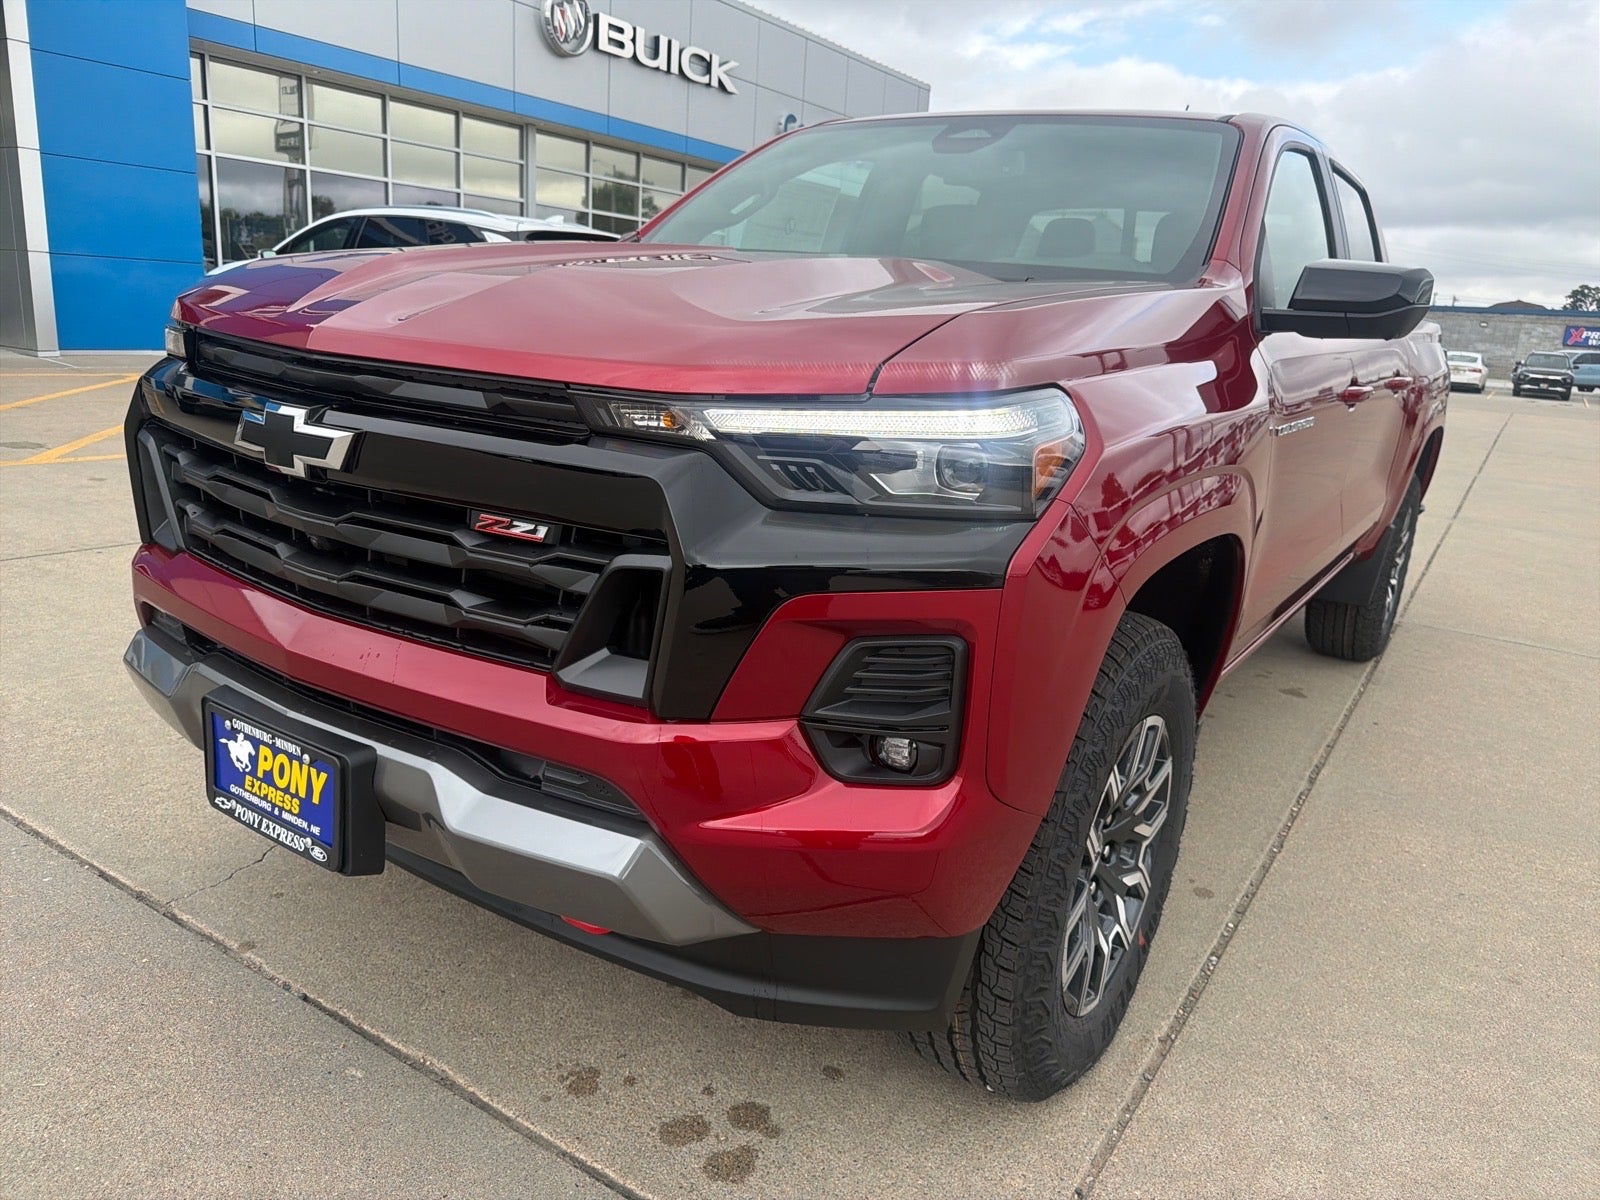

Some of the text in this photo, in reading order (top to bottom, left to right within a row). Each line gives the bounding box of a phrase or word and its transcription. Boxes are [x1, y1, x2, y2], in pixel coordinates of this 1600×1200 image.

[597, 12, 740, 95] BUICK
[1567, 327, 1600, 346] XPR
[475, 513, 549, 543] Z71
[232, 718, 302, 757] GOTHENBURG-MINDEN
[244, 774, 301, 815] EXPRESS
[257, 744, 328, 805] PONY
[229, 783, 321, 836] GOTHENBURG & MINDEN, NE
[234, 803, 306, 852] PONY EXPRESS
